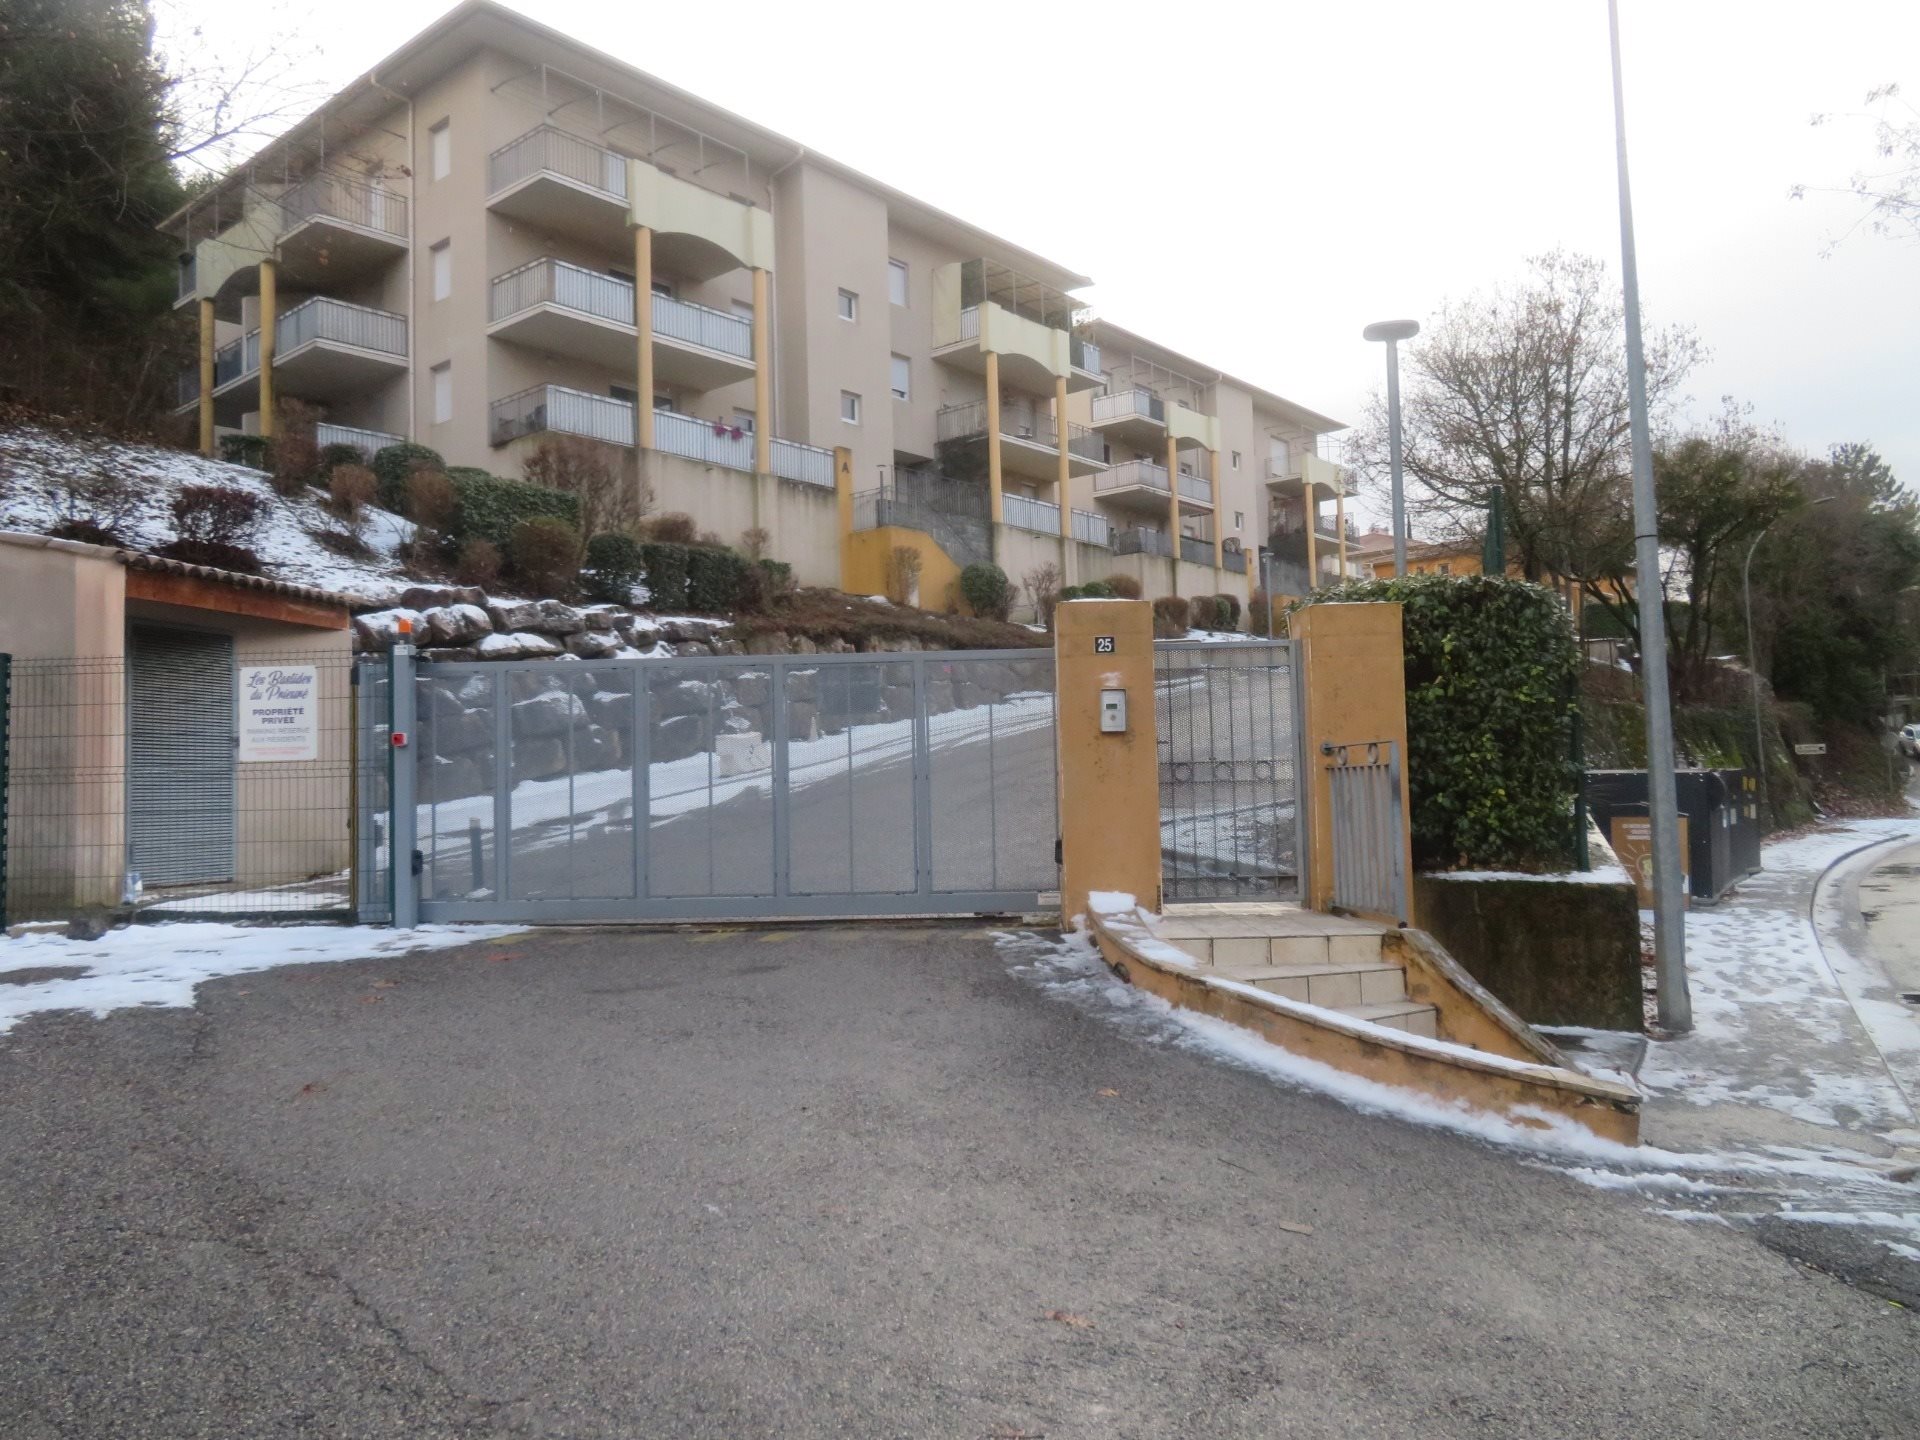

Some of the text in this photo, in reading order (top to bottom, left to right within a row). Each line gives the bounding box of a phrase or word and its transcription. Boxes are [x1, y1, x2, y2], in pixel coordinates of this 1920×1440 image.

[841, 461, 850, 474] A
[1097, 638, 1112, 652] 25
[247, 670, 313, 688] Les Bastides
[249, 686, 309, 700] du Prieuré
